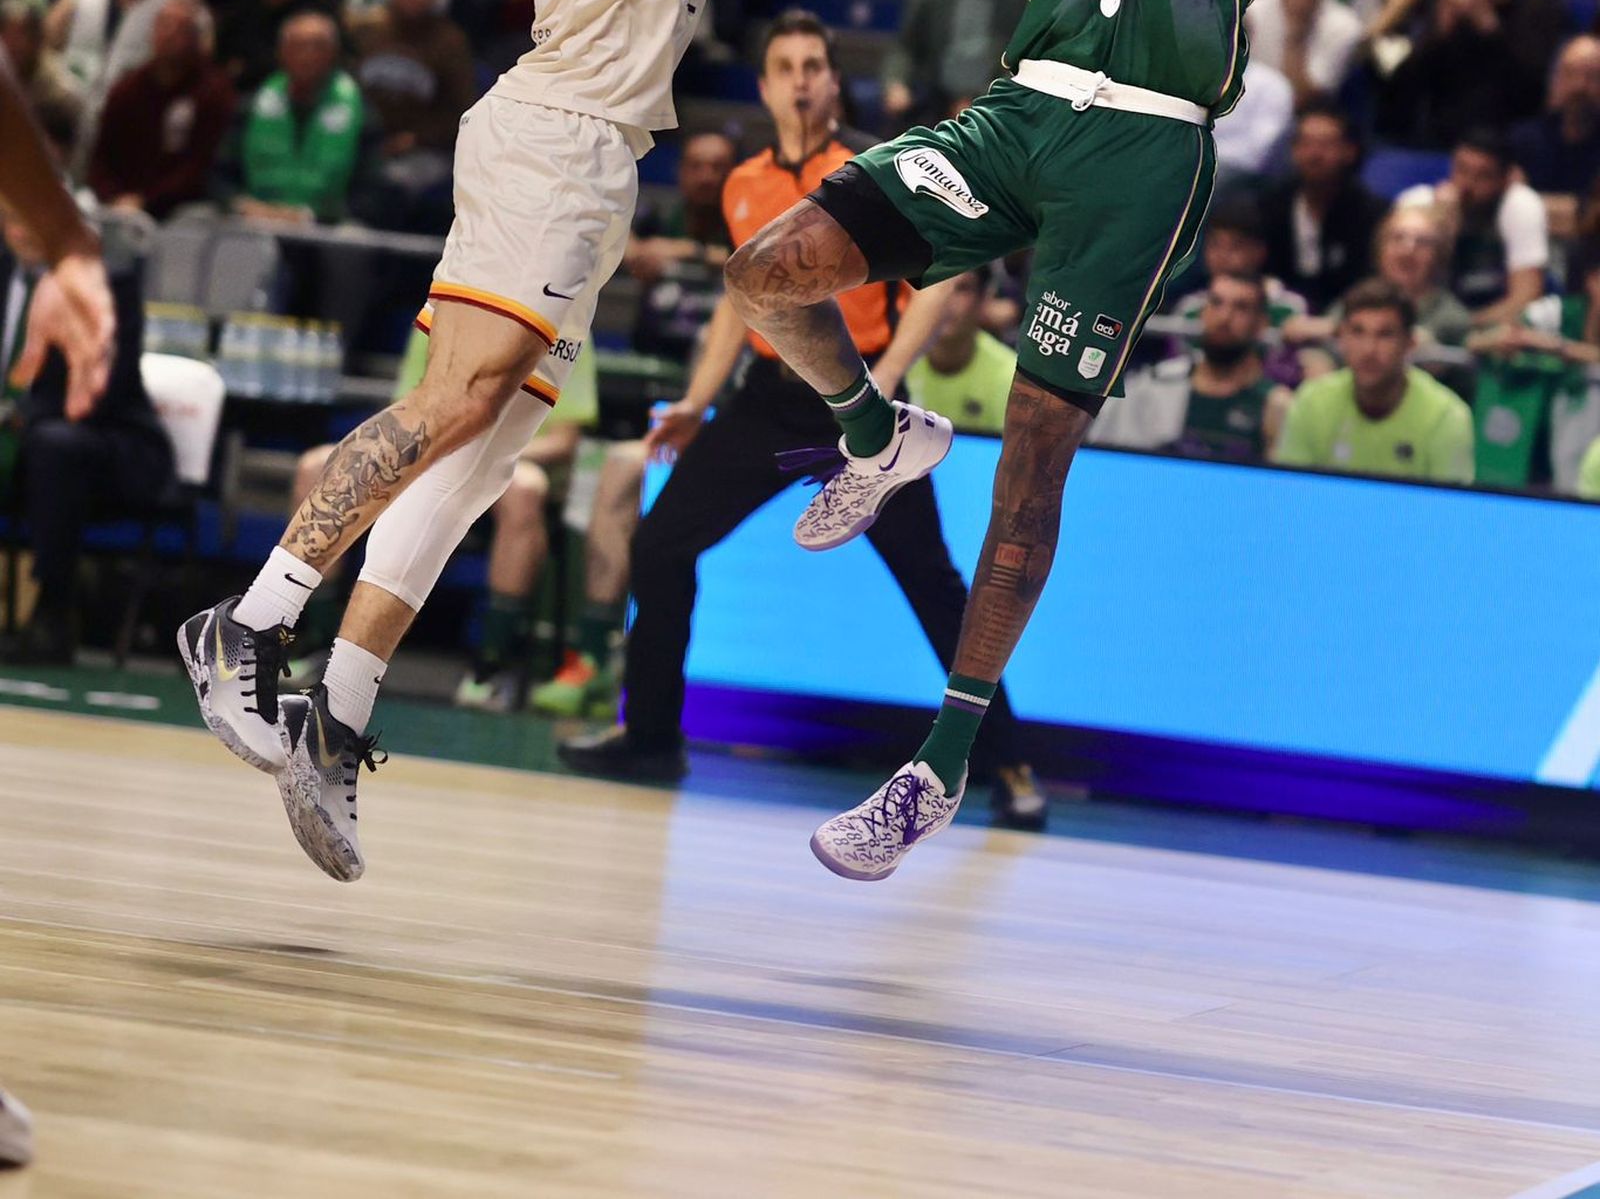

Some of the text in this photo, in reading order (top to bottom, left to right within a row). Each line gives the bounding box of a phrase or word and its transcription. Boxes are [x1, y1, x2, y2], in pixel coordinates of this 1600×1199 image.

[1041, 290, 1072, 311] sabor
[1026, 314, 1072, 356] laga
[1096, 323, 1115, 336] acb
